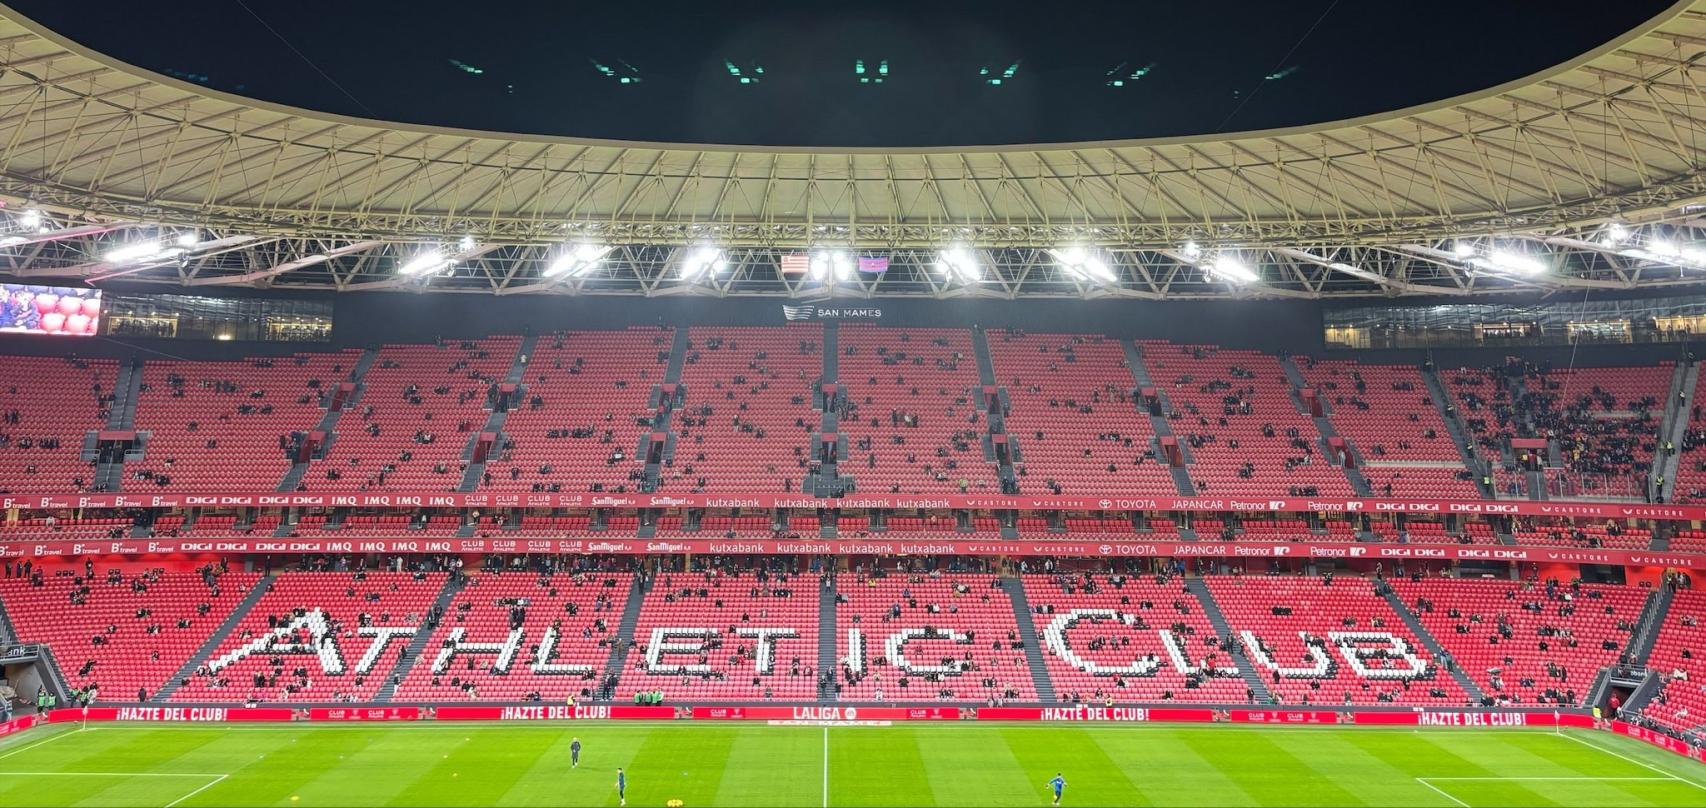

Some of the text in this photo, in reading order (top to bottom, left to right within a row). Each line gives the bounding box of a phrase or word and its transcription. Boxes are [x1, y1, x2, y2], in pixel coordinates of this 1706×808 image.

[818, 309, 838, 317] SAN
[331, 496, 356, 506] IMQ
[365, 496, 390, 506] IMQ
[397, 496, 422, 506] IMQ
[429, 496, 454, 506] IMQ
[706, 498, 759, 508] kutxabank
[774, 498, 827, 508] kutxabank
[837, 498, 889, 508] kutxabank
[897, 498, 949, 508] kutxabank
[1116, 500, 1156, 508] TOYOTA
[1172, 500, 1223, 509] JAPANCAR
[1230, 501, 1266, 510] Petronor
[1308, 501, 1343, 510] Petronor
[1410, 503, 1439, 511] DIGI
[1450, 504, 1480, 512] DIGI
[327, 542, 352, 551] IMQ
[360, 542, 385, 551] IMQ
[392, 542, 417, 551] IMQ
[426, 542, 451, 551] IMQ
[710, 543, 763, 553] kutxabank
[777, 543, 831, 553] kutxabank
[840, 543, 893, 553] kutxabank
[901, 543, 954, 553] kutxabank
[1116, 545, 1156, 554] TOYOTA
[1174, 546, 1226, 554] JAPANCAR
[1235, 546, 1270, 556] Petronor
[1311, 547, 1346, 556] Petronor
[1381, 548, 1410, 556] DIGI
[1415, 548, 1444, 556] DIGI
[1458, 550, 1489, 558] DIGI
[165, 708, 186, 721] DEL
[191, 708, 227, 721] CLUB!
[548, 706, 570, 719] DEL
[575, 706, 610, 719] CLUB!
[794, 707, 840, 719] LALIGA
[1088, 708, 1108, 721] DEL
[1113, 708, 1149, 721] CLUB!
[1465, 713, 1486, 725] DEL
[1491, 713, 1526, 725] CLUB!
